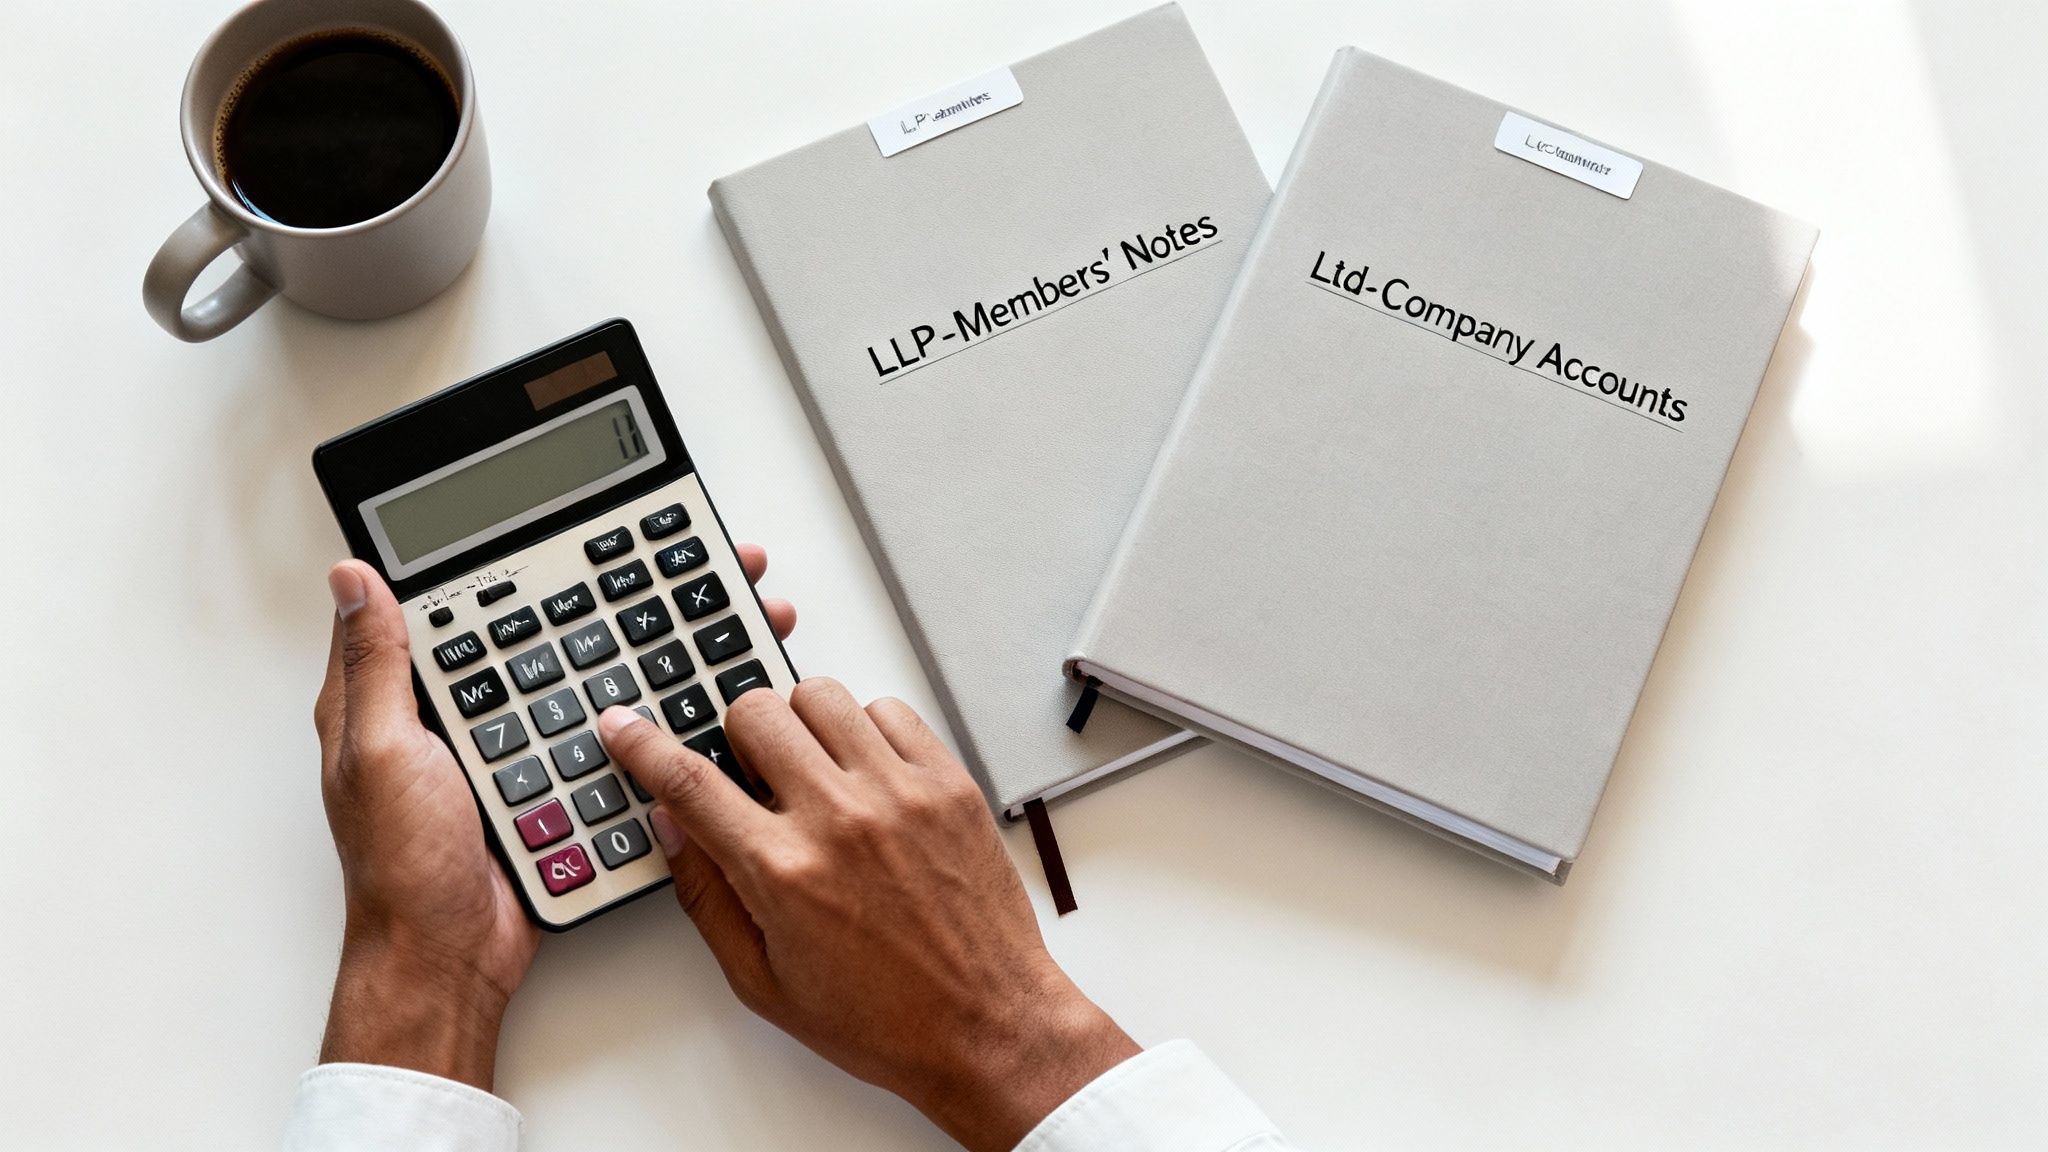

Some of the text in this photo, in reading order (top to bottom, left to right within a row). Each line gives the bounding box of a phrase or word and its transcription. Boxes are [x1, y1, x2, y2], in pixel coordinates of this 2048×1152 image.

[1120, 216, 1218, 271] Notes
[1310, 251, 1688, 422] Ltd-Company Accounts
[485, 722, 506, 749] 7
[610, 831, 630, 854] 0
